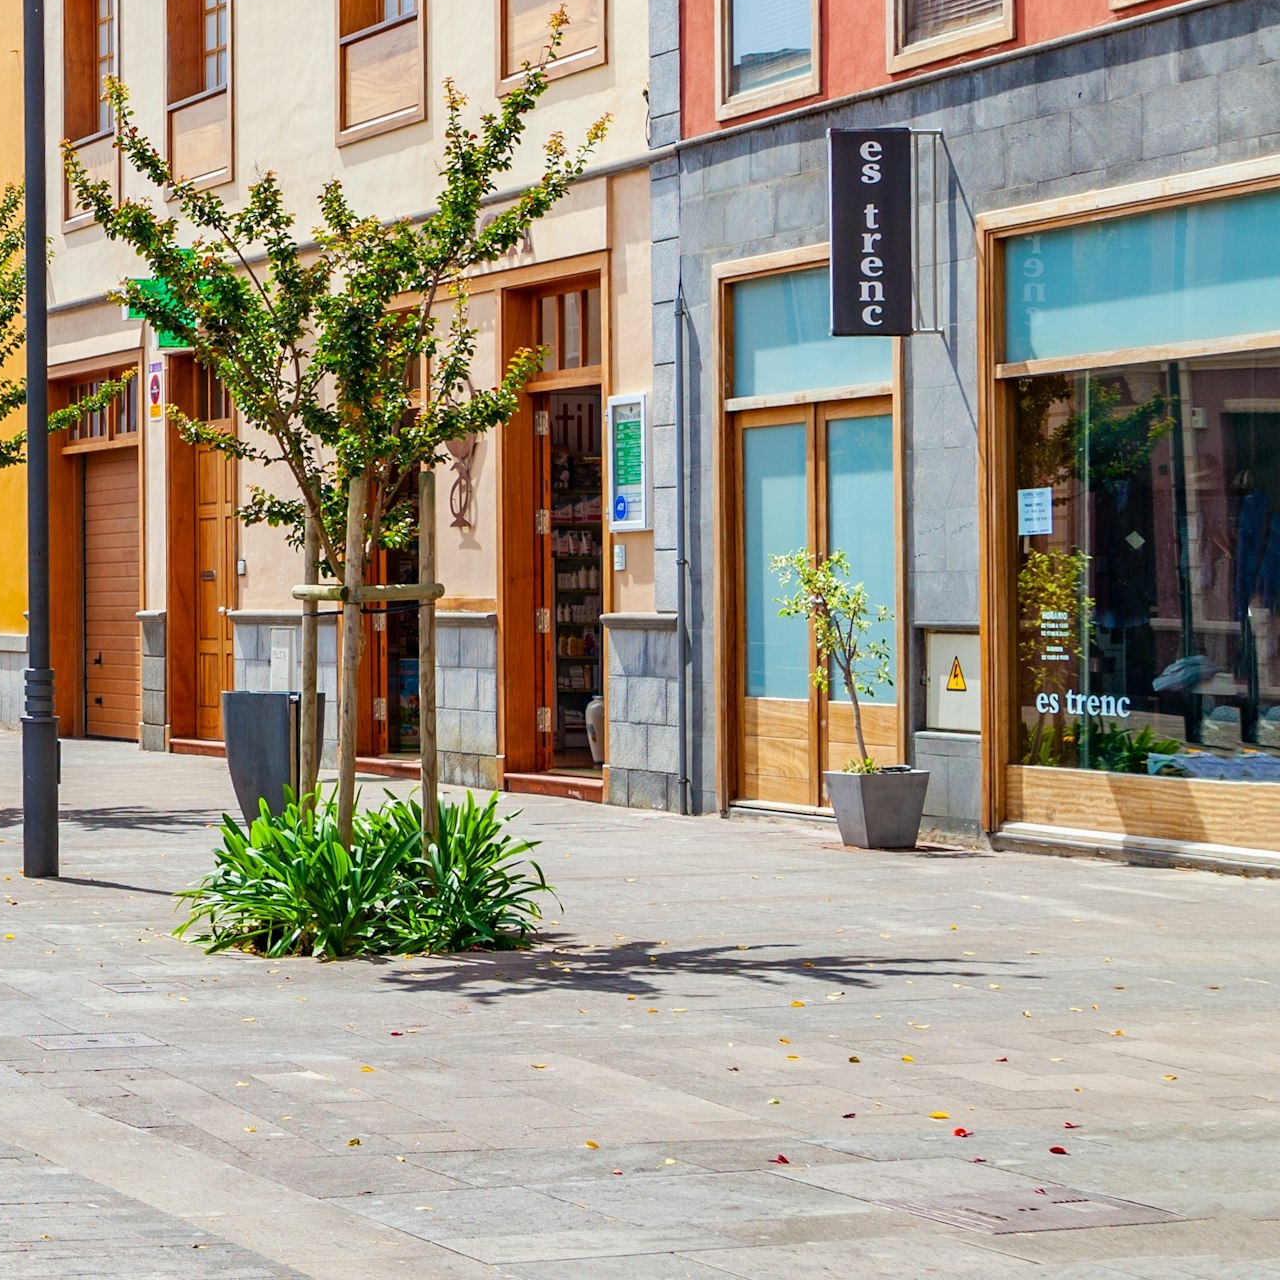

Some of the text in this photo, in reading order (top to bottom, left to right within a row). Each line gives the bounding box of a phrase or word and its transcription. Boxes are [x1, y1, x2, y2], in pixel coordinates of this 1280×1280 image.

[858, 140, 886, 326] es trenc
[1035, 688, 1131, 718] es trenc
